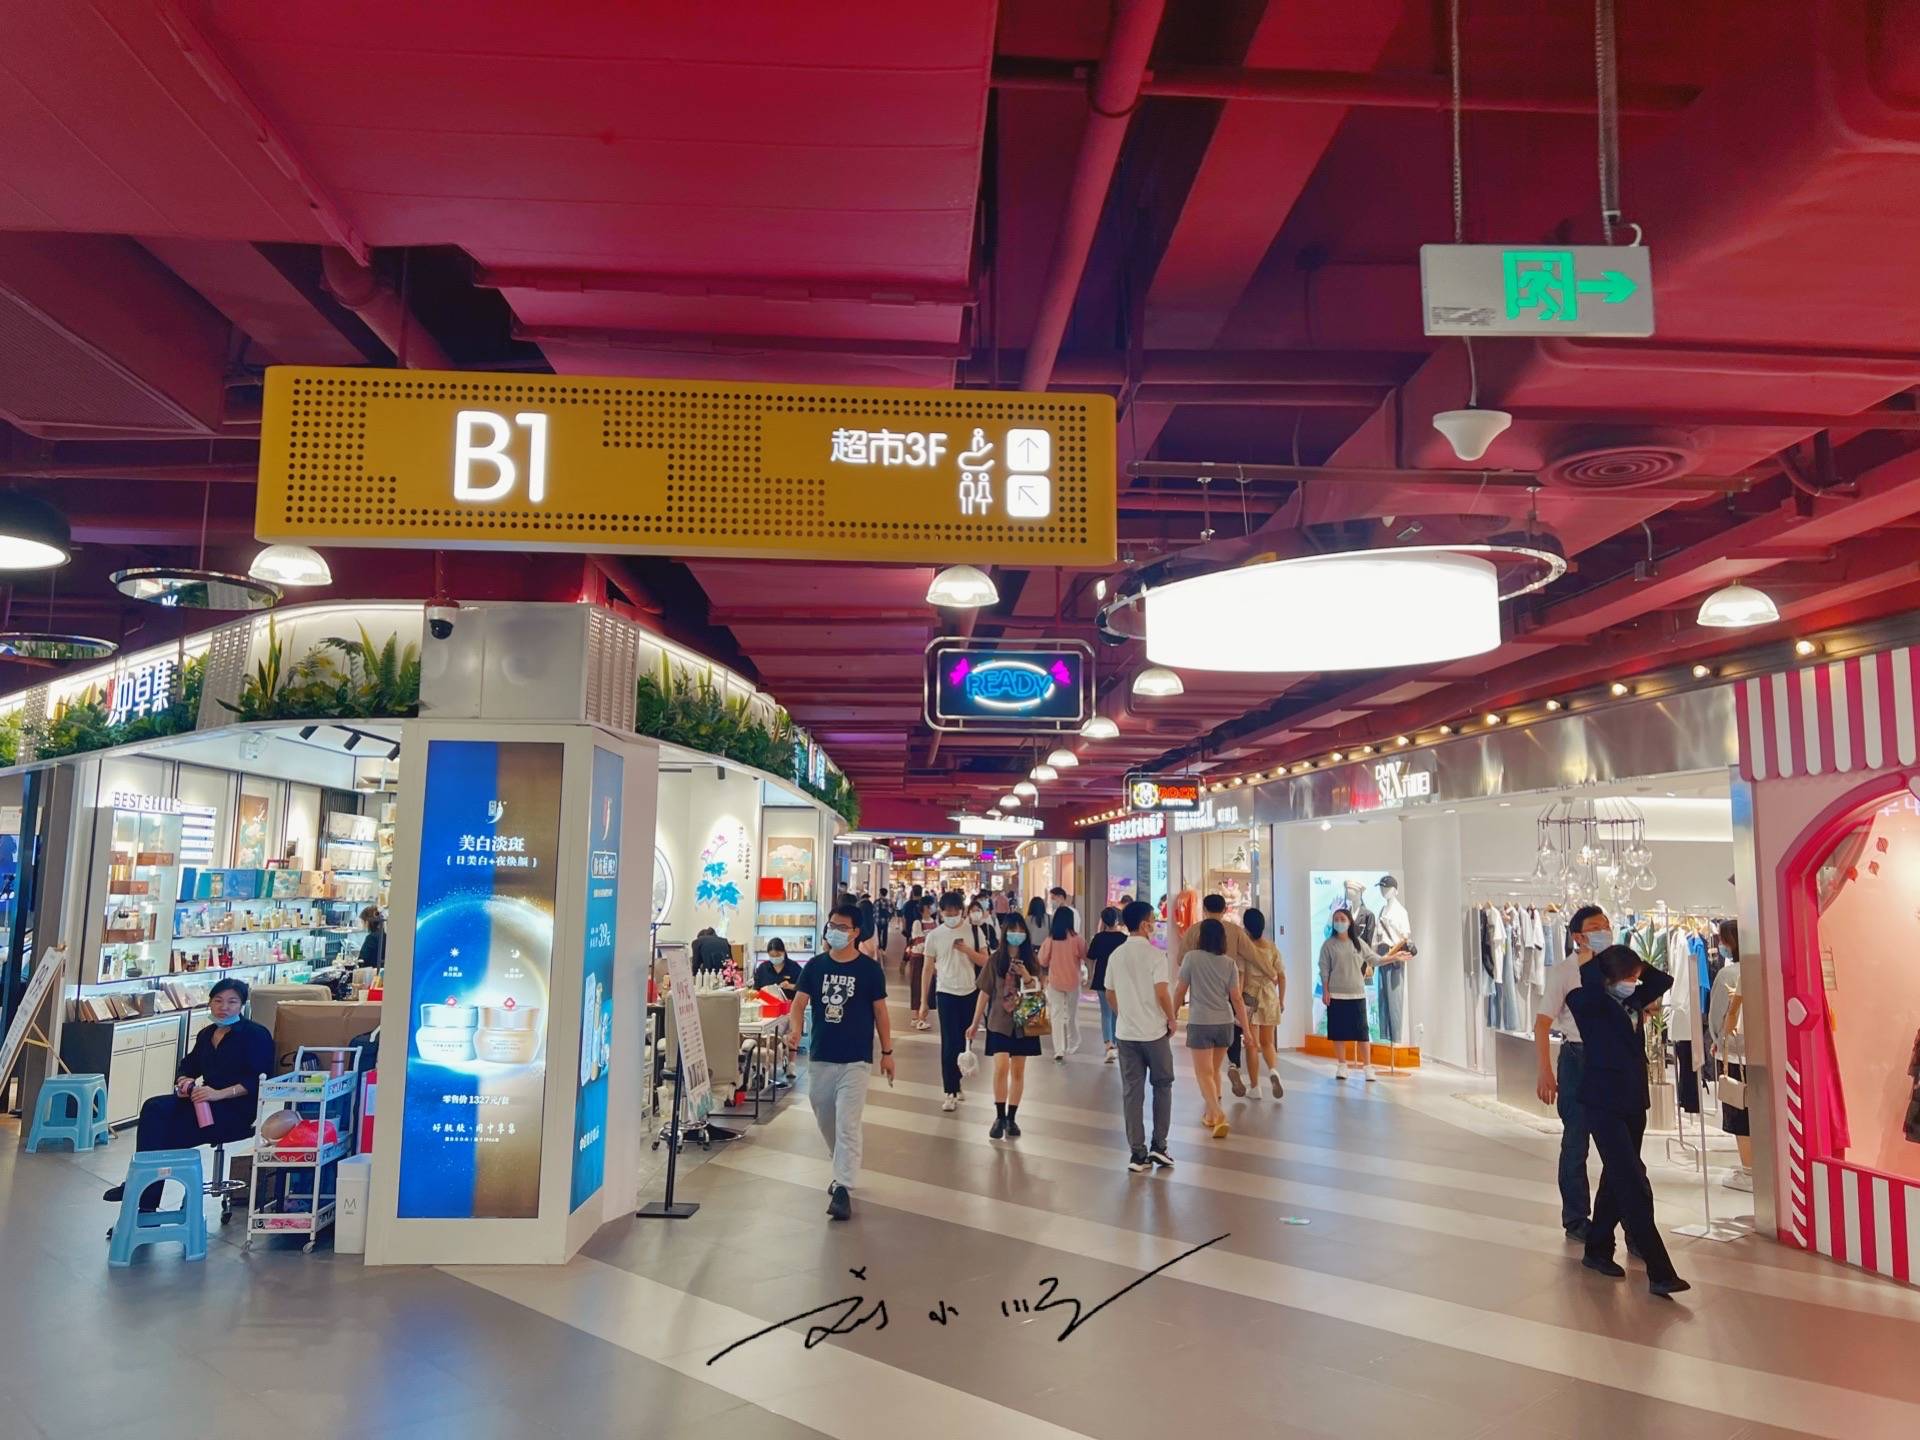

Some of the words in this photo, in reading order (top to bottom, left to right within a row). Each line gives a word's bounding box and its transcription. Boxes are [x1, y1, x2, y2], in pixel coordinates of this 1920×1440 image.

[453, 410, 547, 503] B1
[830, 427, 948, 467] 超市3F
[966, 670, 1054, 698] READY
[113, 791, 143, 809] BEST
[1158, 786, 1197, 799] ROCK
[459, 834, 525, 852] 美白淡斑
